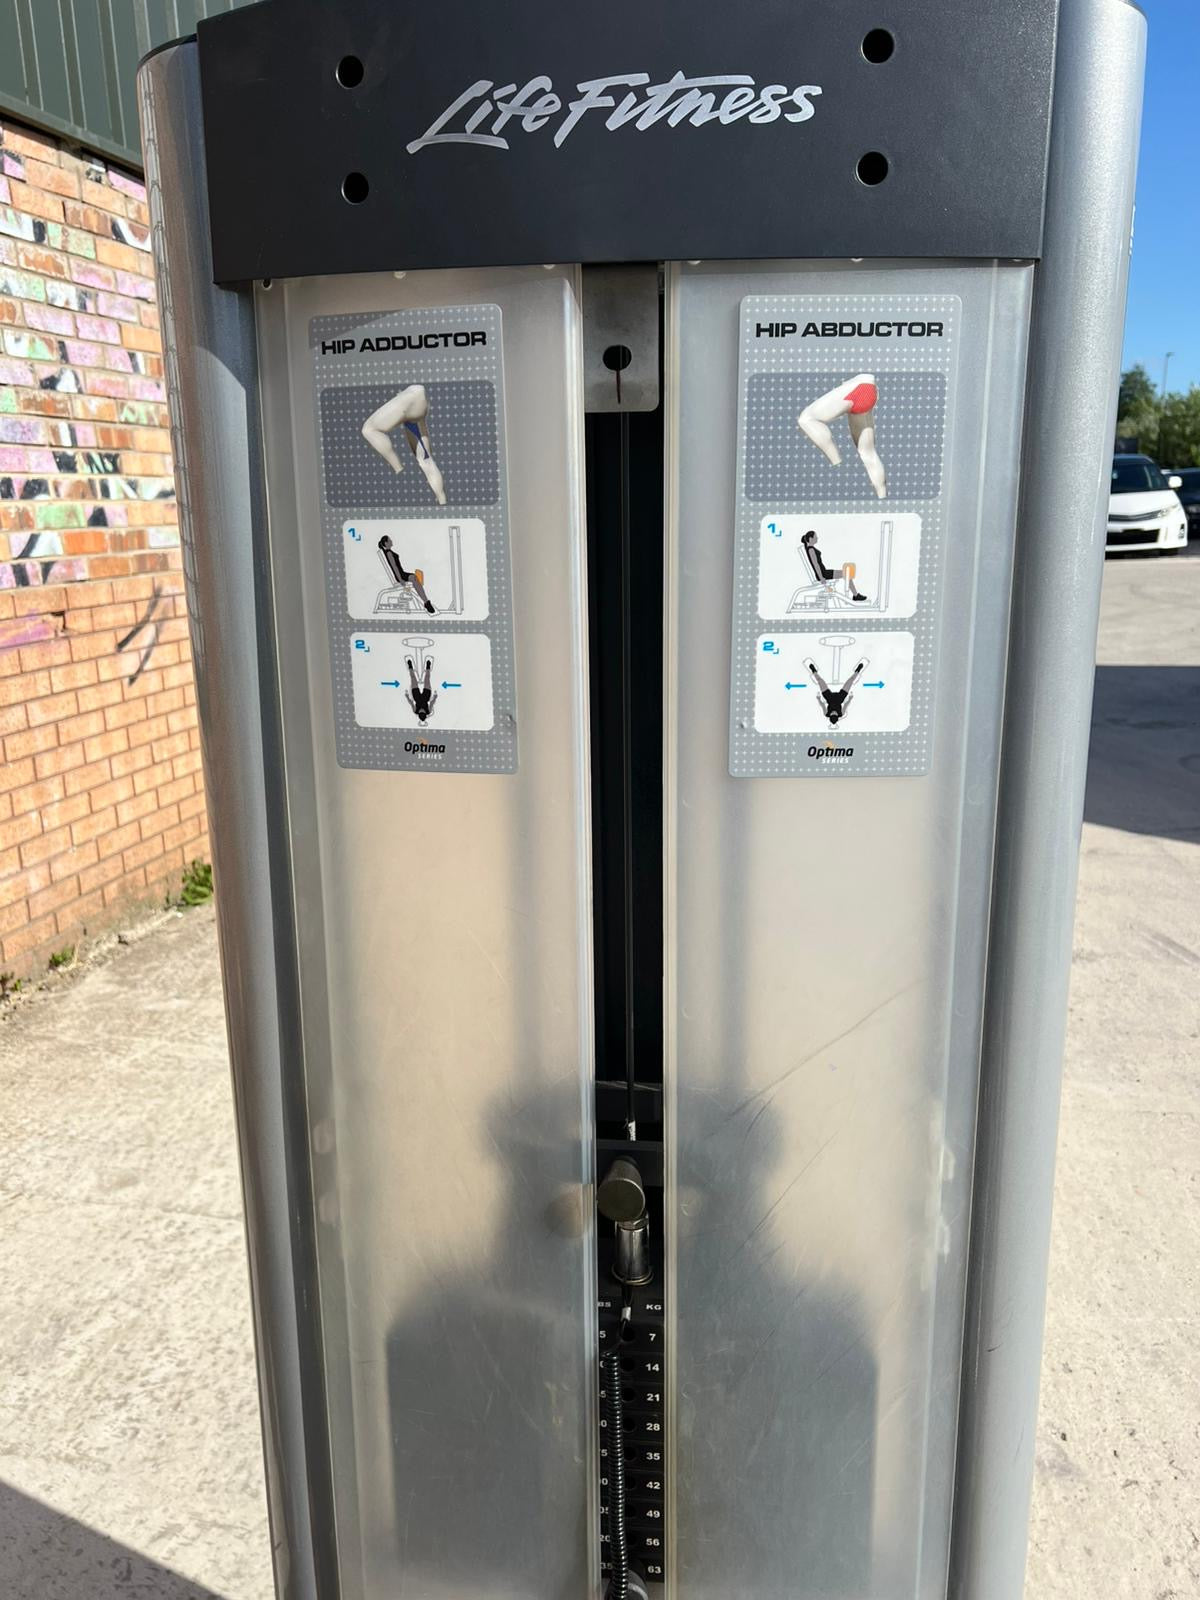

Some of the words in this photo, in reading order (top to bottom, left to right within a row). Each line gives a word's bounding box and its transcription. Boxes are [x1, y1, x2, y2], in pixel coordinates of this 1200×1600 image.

[406, 75, 562, 154] Life
[554, 70, 822, 148] Fitness
[755, 322, 797, 338] HIP
[801, 321, 944, 337] ABDUCTOR
[321, 339, 355, 355] HIP
[359, 331, 487, 353] ADDUCTOR
[404, 741, 446, 754] Optima
[807, 746, 854, 760] Optima
[649, 1333, 656, 1341] 7
[645, 1363, 660, 1371] 14
[646, 1393, 660, 1402] 21
[646, 1422, 661, 1431] 28
[646, 1452, 661, 1461] 35
[646, 1481, 661, 1490] 42
[646, 1510, 661, 1519] 49
[646, 1538, 660, 1547] 56
[647, 1565, 662, 1575] 63
